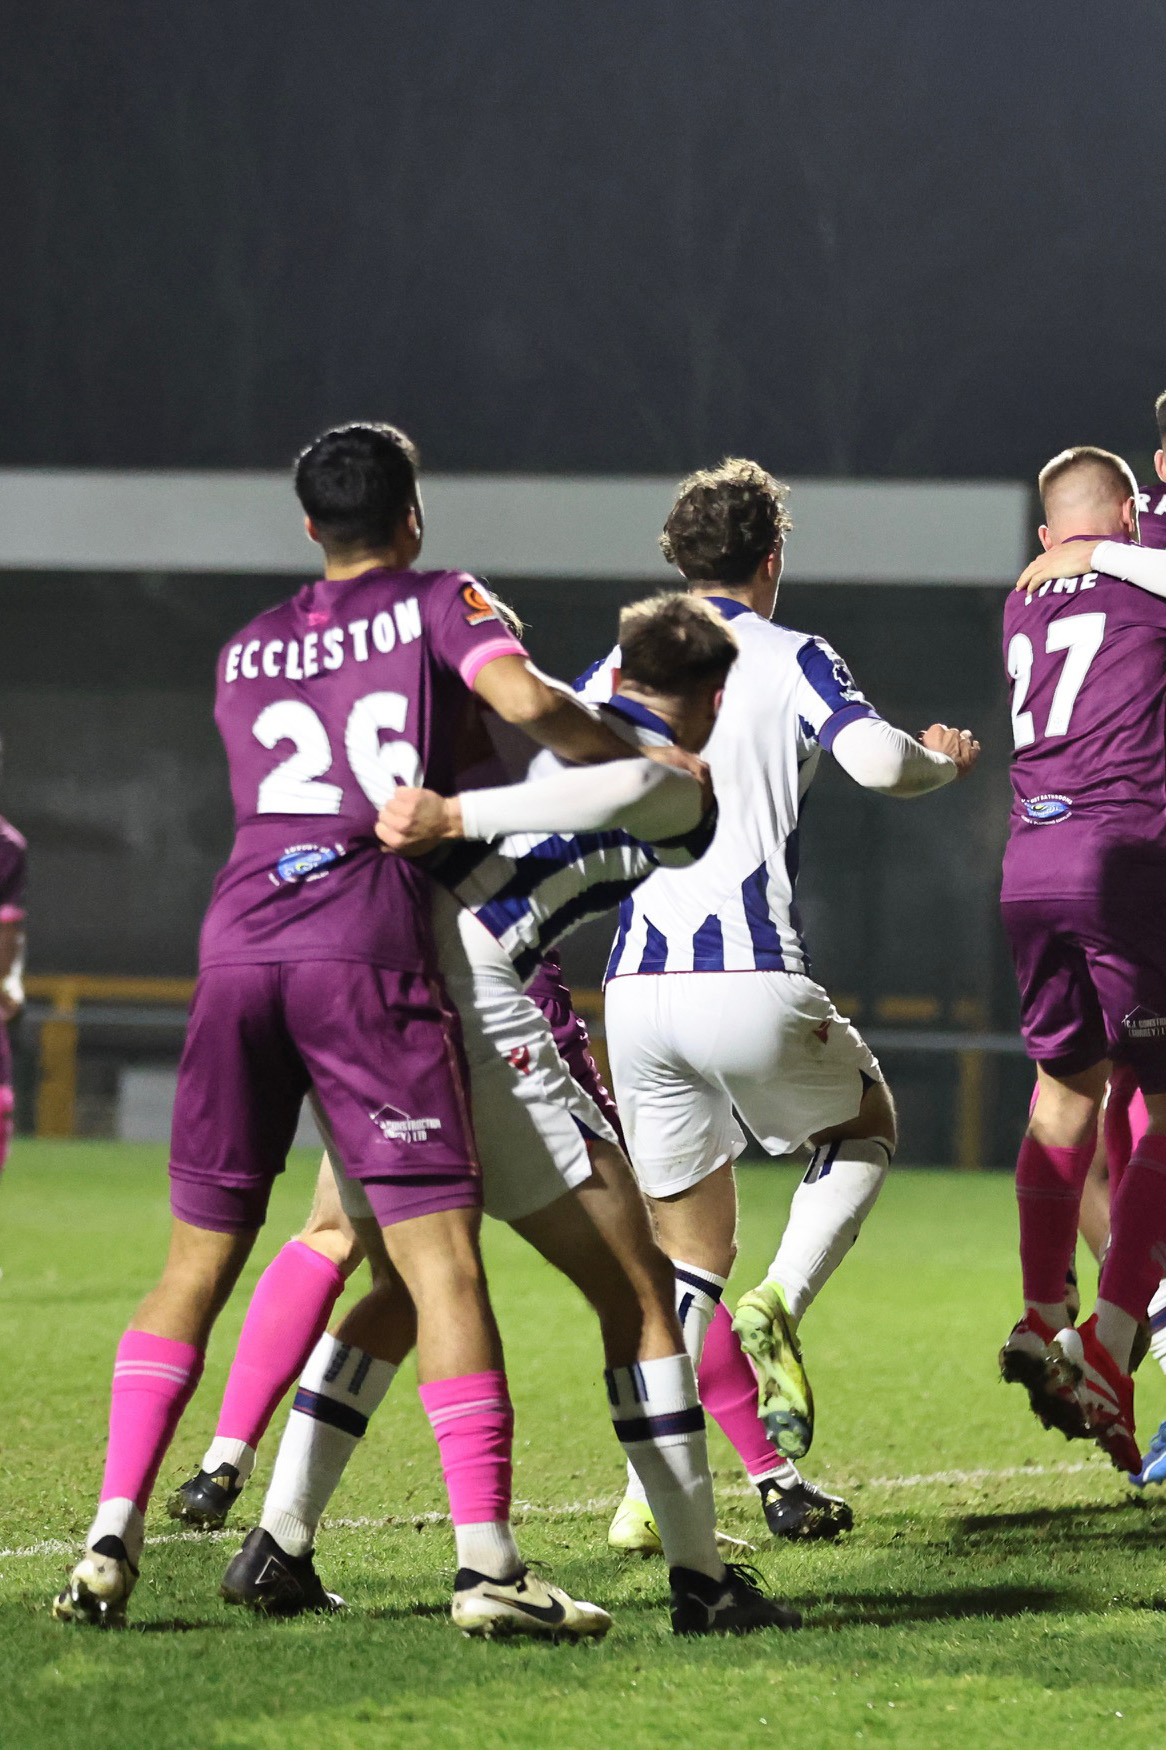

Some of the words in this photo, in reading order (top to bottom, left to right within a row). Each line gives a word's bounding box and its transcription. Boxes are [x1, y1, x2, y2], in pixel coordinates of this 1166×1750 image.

[225, 596, 422, 683] ECCLESTON
[1008, 612, 1107, 750] 27
[252, 691, 425, 814] 26
